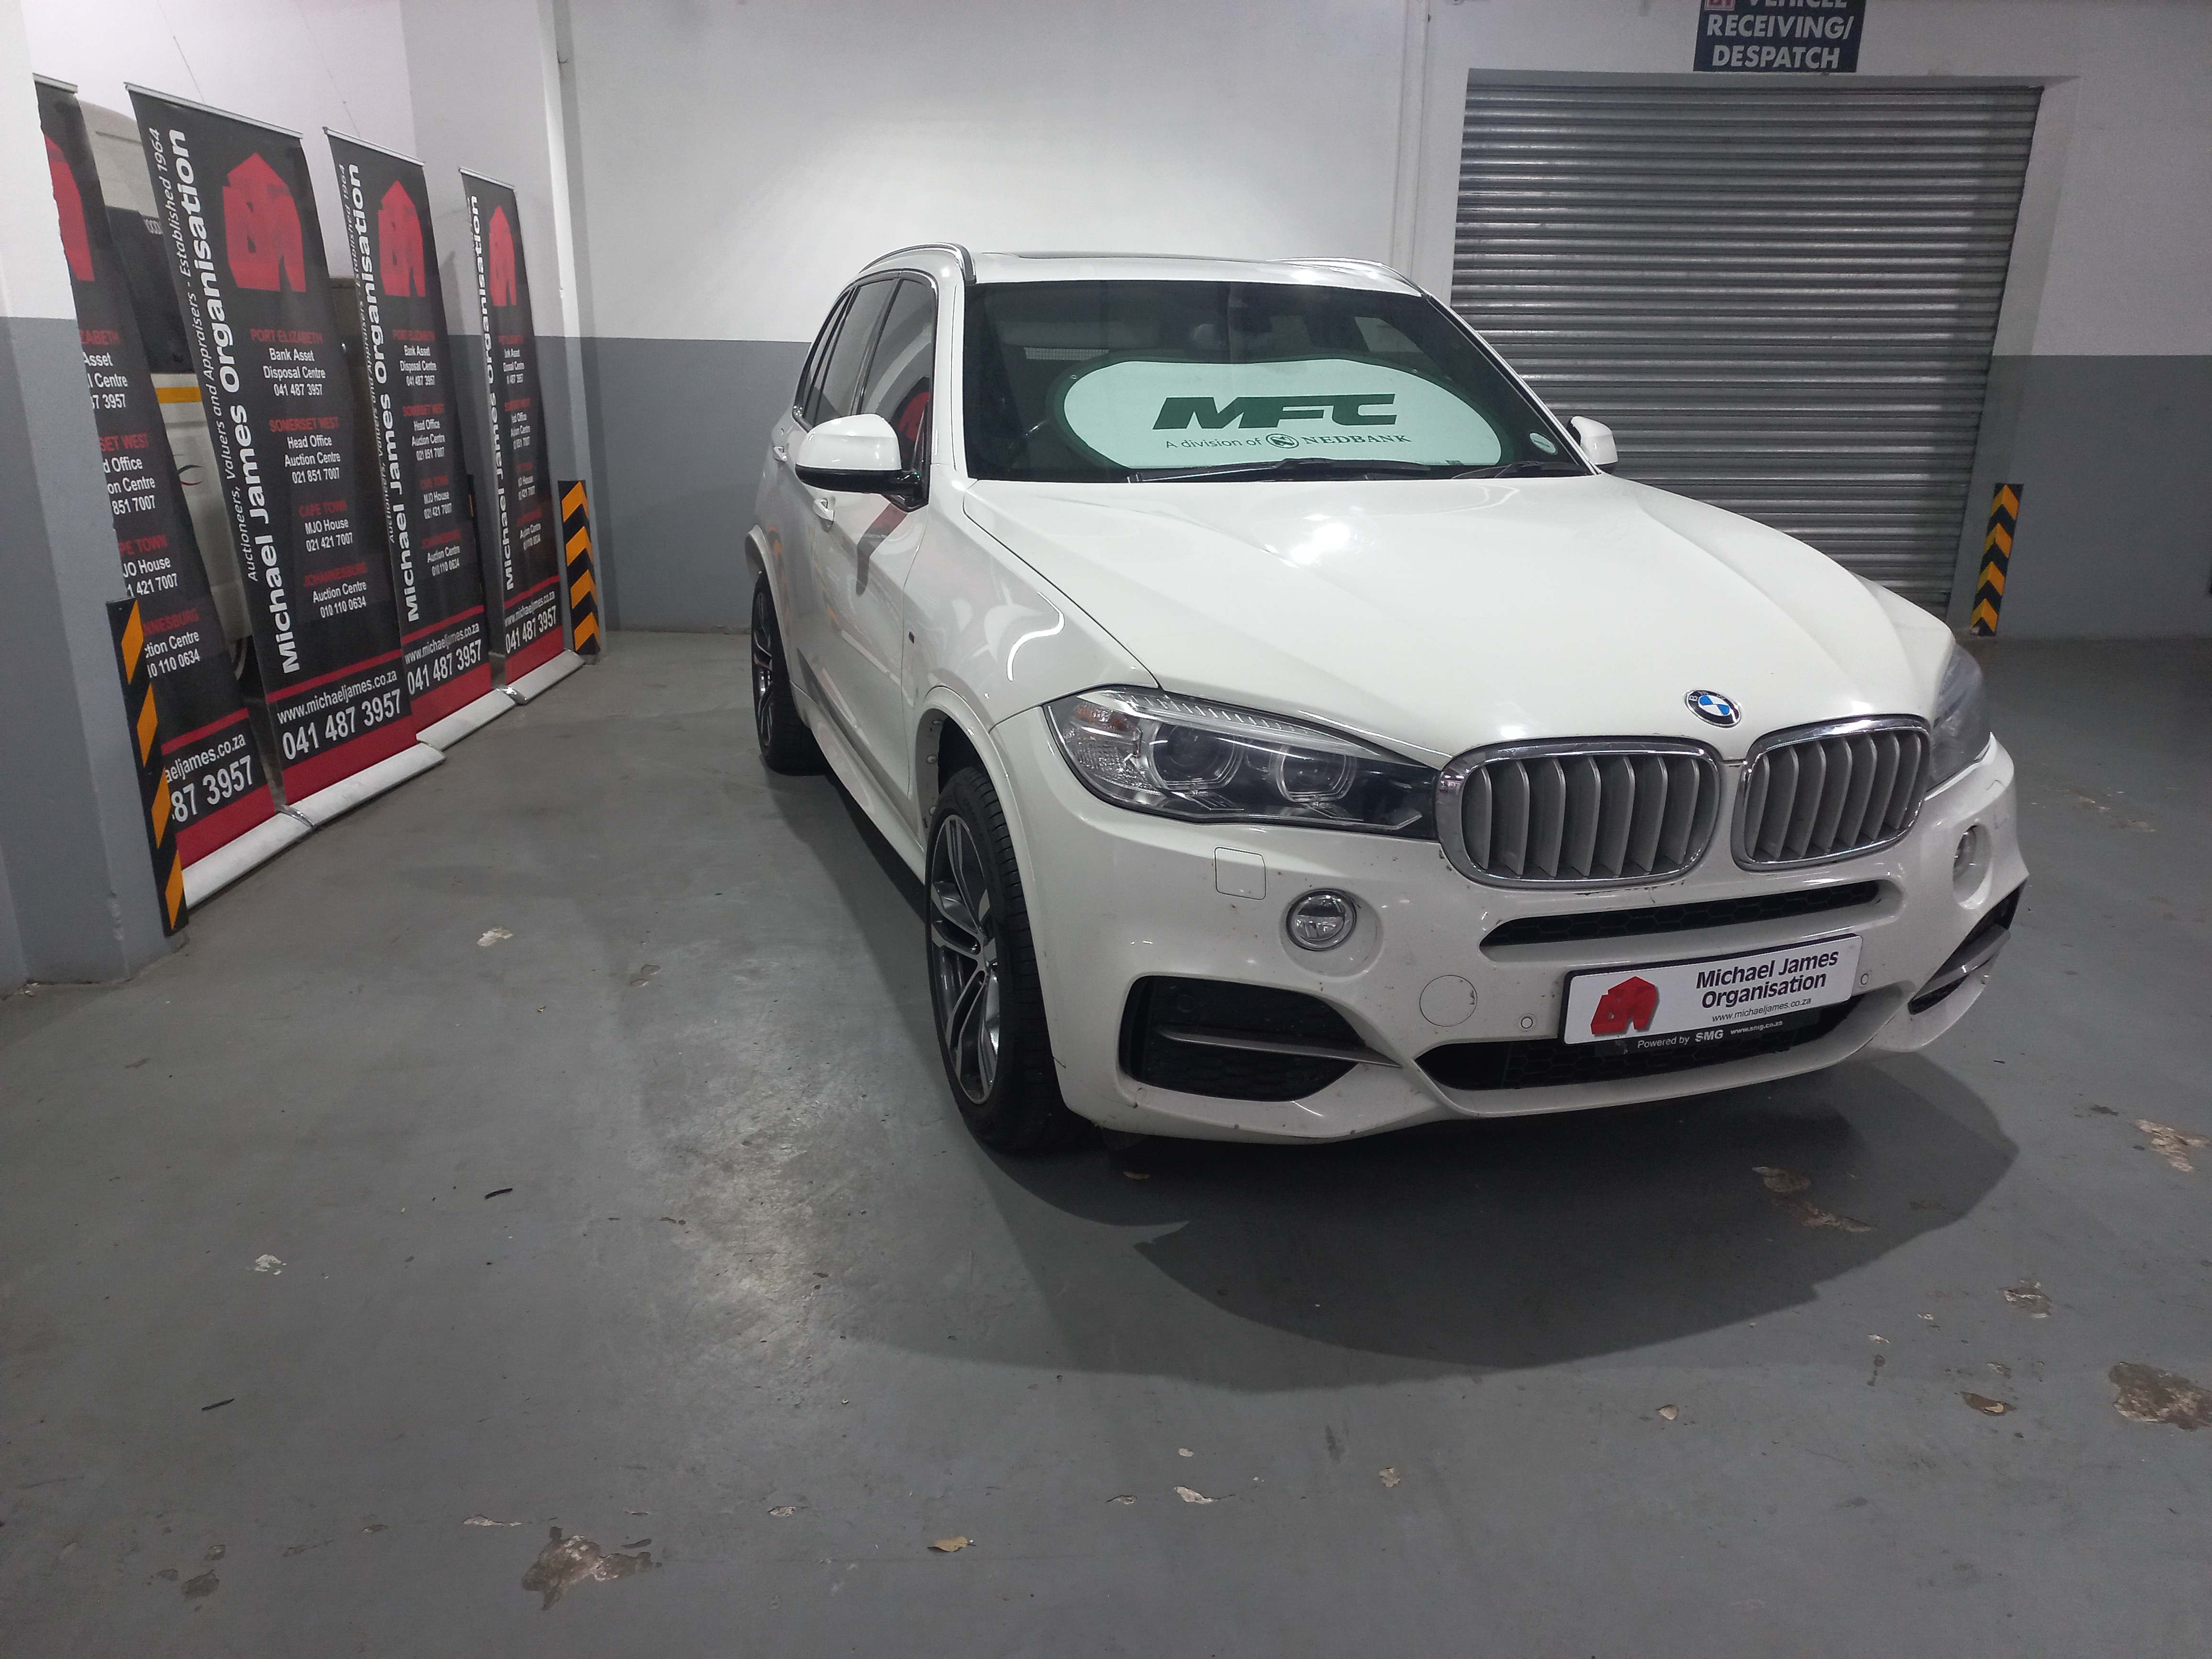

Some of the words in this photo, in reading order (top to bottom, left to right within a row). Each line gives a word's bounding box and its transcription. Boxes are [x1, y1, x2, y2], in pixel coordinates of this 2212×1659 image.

[1707, 14, 1854, 40] RECEIVING/
[1712, 44, 1840, 69] DESPATCH
[149, 127, 167, 172] 1964
[159, 176, 191, 277] Established
[169, 129, 240, 393] Organisation
[348, 164, 387, 384] Organisation
[188, 292, 214, 381] Appraisers
[268, 347, 292, 361] Bank
[293, 348, 315, 361] Asset
[94, 373, 128, 387] Centre
[263, 365, 301, 381] Disposal
[302, 366, 326, 379] Centre
[102, 394, 126, 409] 3957
[206, 384, 222, 417] and
[274, 383, 288, 396] 041
[290, 384, 305, 396] 487
[308, 384, 323, 396] 3957
[1152, 393, 1397, 430] MFC
[216, 420, 236, 479] Valuers
[287, 435, 309, 449] Head
[310, 434, 332, 447] Office
[380, 394, 402, 495] James
[1166, 440, 1178, 448] A
[1181, 439, 1242, 448] division
[1247, 437, 1262, 446] of
[1302, 435, 1412, 445] NEDBANK
[111, 456, 143, 472] Office
[230, 405, 269, 524] James
[284, 453, 316, 467] Auction
[317, 452, 341, 464] Centre
[122, 476, 156, 492] Centre
[292, 471, 306, 484] 021
[307, 469, 322, 482] 851
[323, 467, 340, 480] 7007
[112, 498, 131, 515] 851
[132, 495, 156, 512] 7007
[232, 486, 258, 582] Auctioneers,
[305, 520, 322, 535] MJO
[323, 519, 349, 531] House
[498, 487, 514, 590] Michael
[306, 538, 320, 552] 021
[321, 535, 335, 549] 421
[336, 532, 353, 546] 7007
[138, 557, 171, 574] House
[393, 504, 419, 622] Michael
[137, 579, 155, 595] 421
[155, 573, 178, 591] 7007
[313, 587, 341, 603] Auction
[342, 581, 367, 596] Centre
[254, 535, 300, 674] Michael
[320, 604, 333, 619] 010
[334, 600, 347, 614] 110
[348, 596, 366, 610] 0634
[168, 631, 200, 650] Centre
[505, 627, 520, 654] 041
[538, 605, 556, 632] 3957
[159, 657, 177, 674] 110
[178, 649, 200, 667] 0634
[408, 664, 430, 695] 041
[433, 652, 453, 681] 487
[456, 639, 481, 670] 3957
[276, 670, 398, 724] www.michaeljames.co.za
[282, 722, 320, 760] 041
[325, 706, 355, 741] 487
[361, 688, 400, 726] 3957
[165, 734, 246, 784] aeljames.co.za
[172, 783, 198, 822] 87
[202, 755, 253, 805] 3957
[1696, 960, 1776, 989] Michael
[1779, 951, 1839, 976] James
[1702, 973, 1826, 1008] Organisation
[1712, 997, 1812, 1022] www.michaeljames.co.za
[1637, 1036, 1676, 1049] Powered
[1679, 1036, 1690, 1045] by
[1695, 1029, 1724, 1043] SMG
